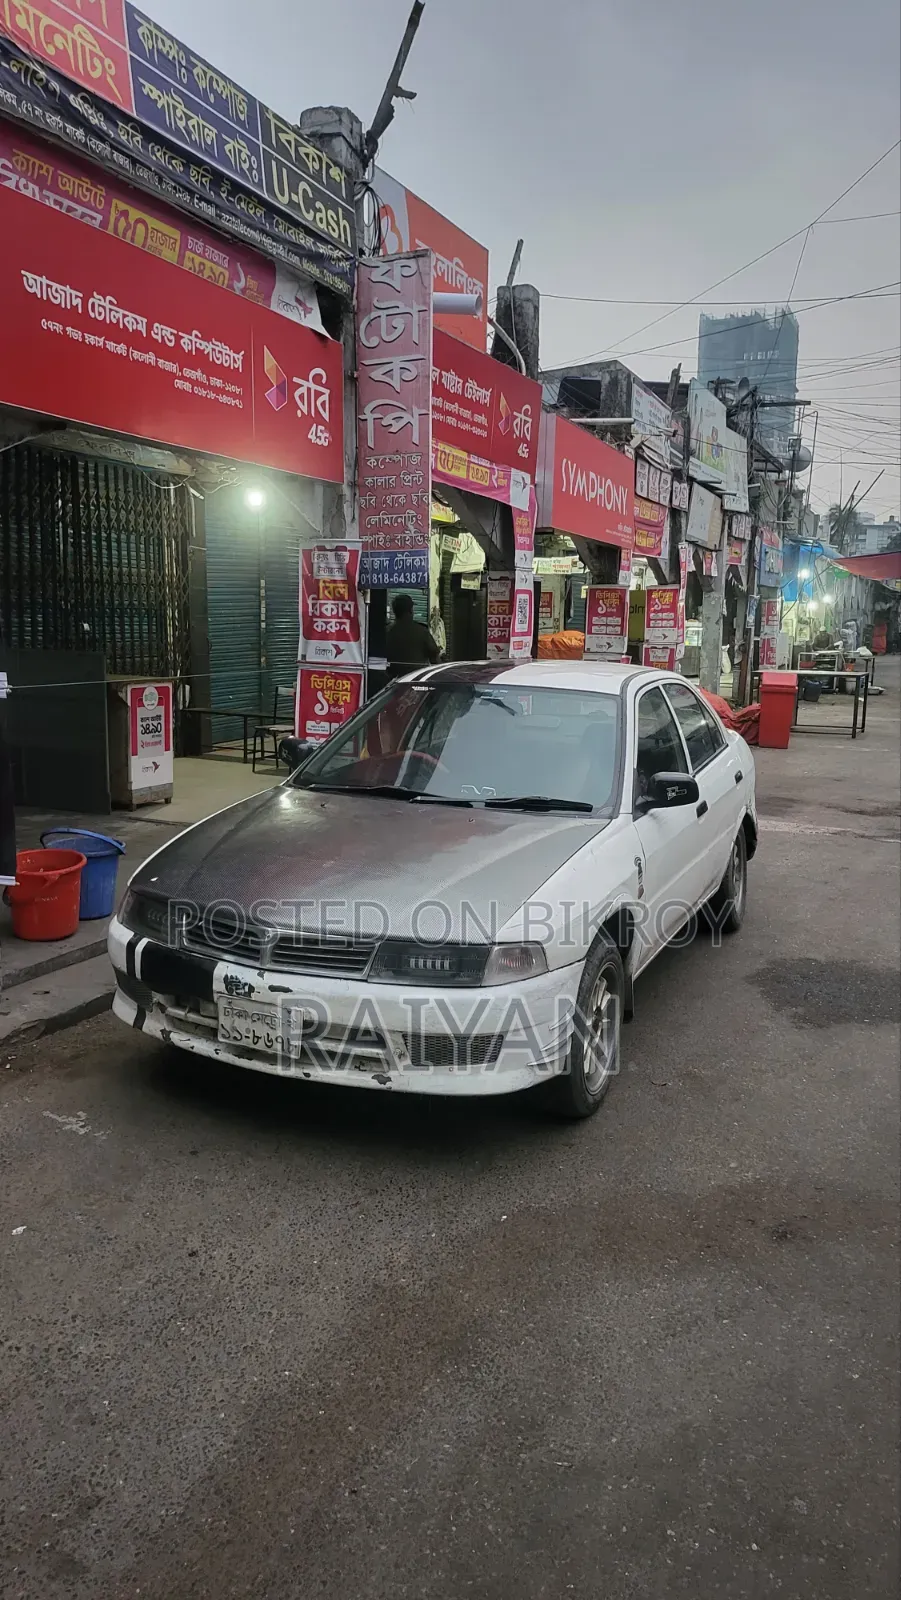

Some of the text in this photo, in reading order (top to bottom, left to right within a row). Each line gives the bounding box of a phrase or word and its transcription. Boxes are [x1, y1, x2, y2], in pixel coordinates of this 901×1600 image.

[12, 149, 55, 185] ক্যাশ
[57, 169, 107, 210] আউটে
[194, 194, 216, 219] E-mail
[272, 157, 352, 248] U-Cash
[150, 226, 178, 253] হাজার
[187, 235, 204, 257] চার্জ
[204, 245, 230, 269] হাজারে
[21, 269, 245, 373] আজাদ টেলিকম এন্ড কম্পিউটার্স
[41, 318, 64, 336] ৫৭নং
[105, 340, 128, 357] মার্কেট
[292, 367, 331, 423] রবি
[513, 404, 533, 441] রবি
[366, 452, 422, 470] কম্পোজ
[364, 470, 424, 490] কালার প্রিন্ট
[562, 458, 628, 516] SYMPHONY
[360, 492, 377, 510] ছবি
[381, 494, 407, 508] থেকে
[411, 489, 430, 507] ছবি
[366, 509, 423, 529] লেমিনেটিং
[361, 552, 428, 573] আজাদ টেলিকম
[318, 579, 349, 600] বিল
[360, 571, 428, 586] 01818-643871
[308, 594, 355, 618] বিকাশ
[312, 618, 351, 634] করুন
[311, 674, 352, 692] ডিপিএস
[314, 690, 329, 716] ১
[323, 690, 352, 706] খুলুন
